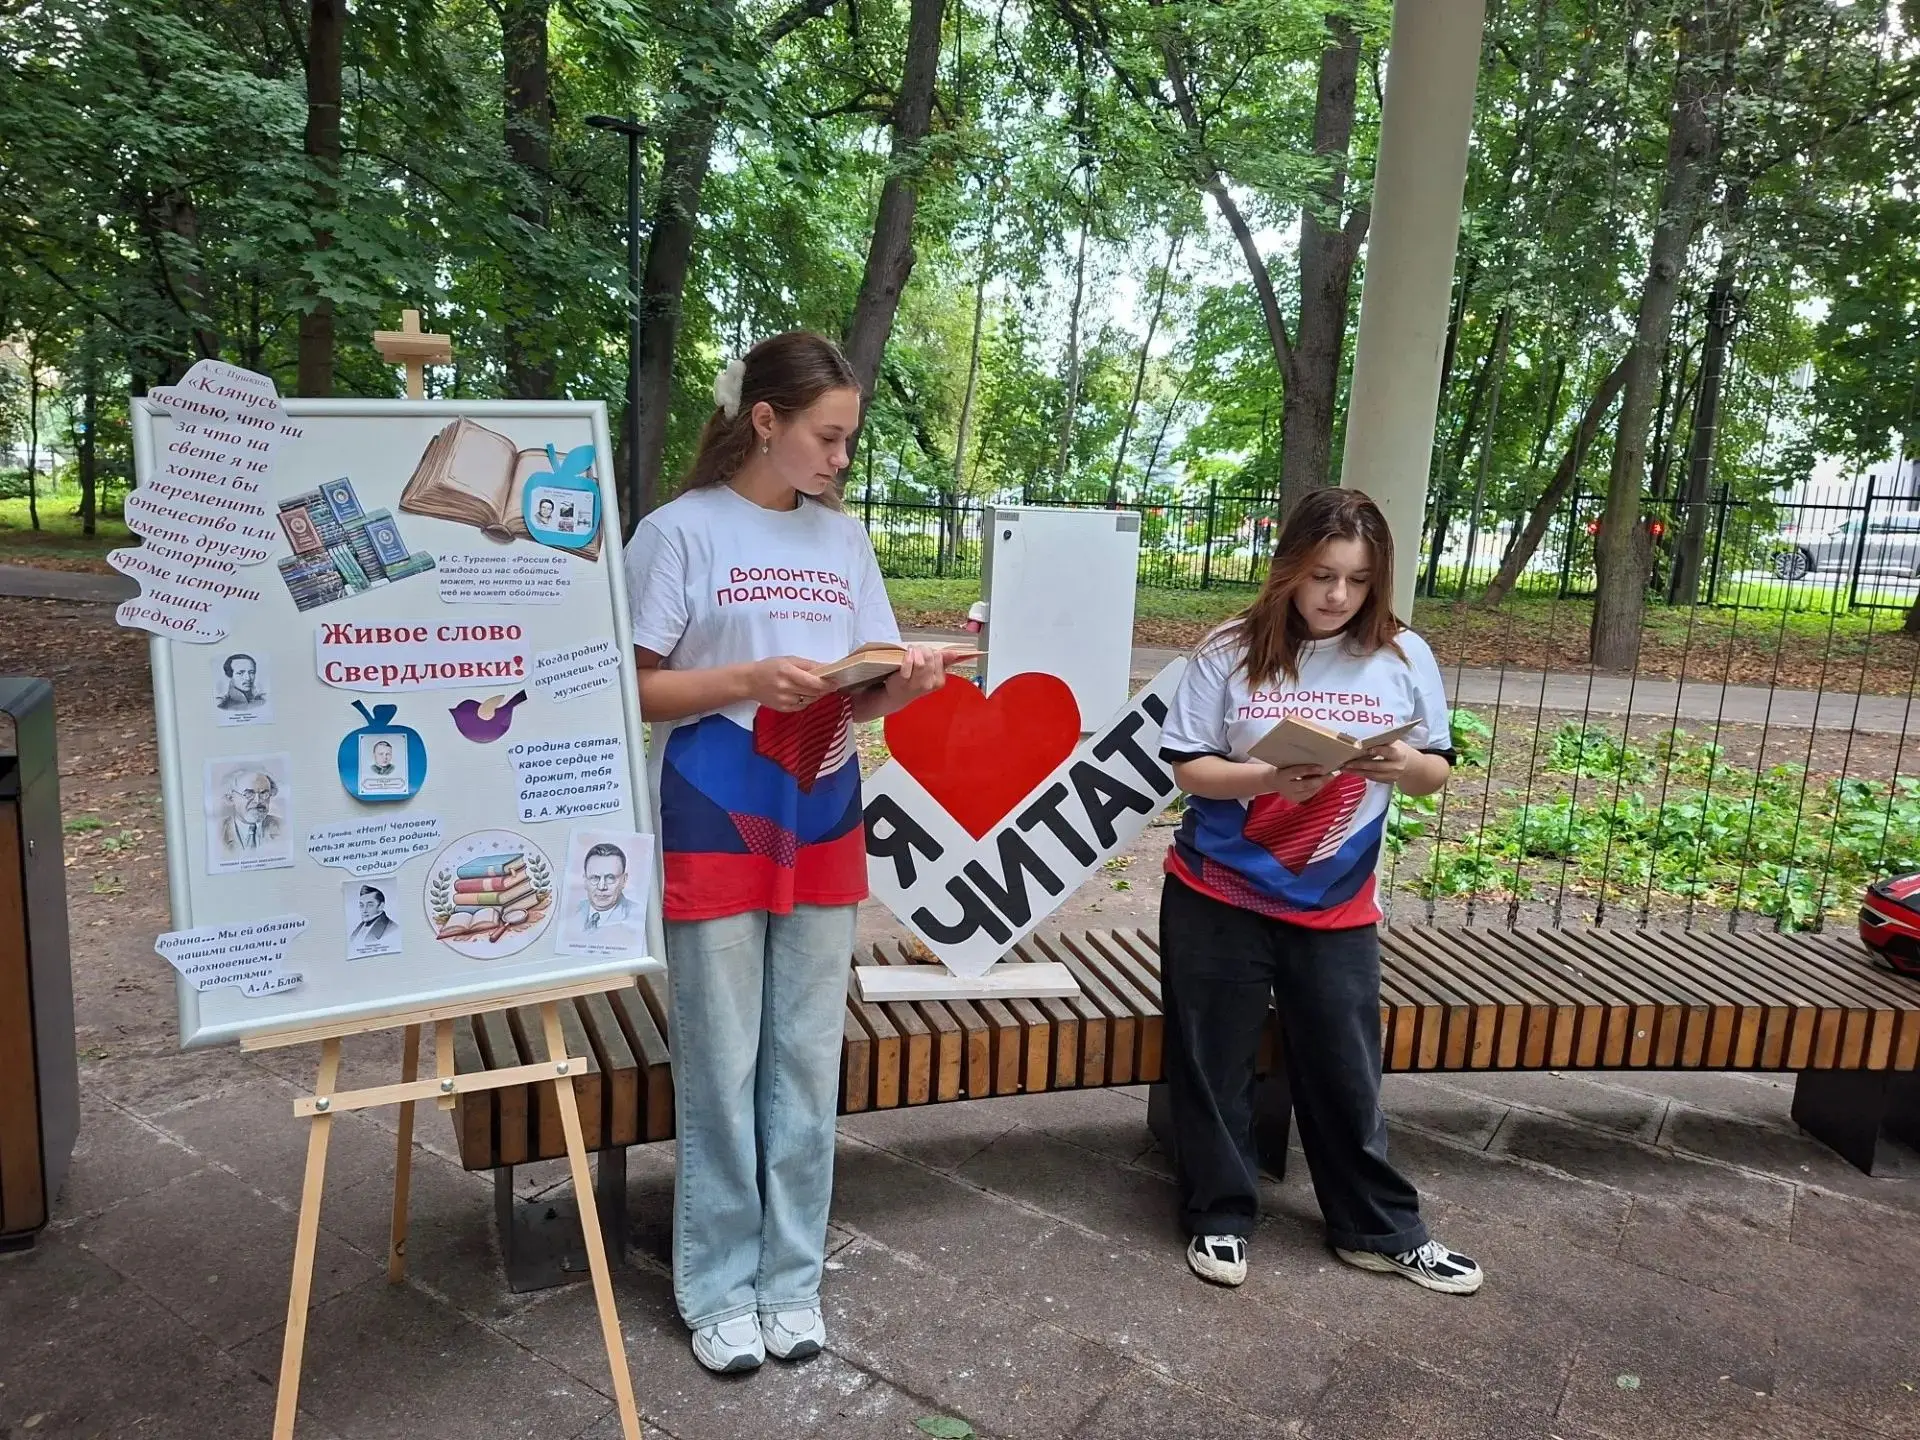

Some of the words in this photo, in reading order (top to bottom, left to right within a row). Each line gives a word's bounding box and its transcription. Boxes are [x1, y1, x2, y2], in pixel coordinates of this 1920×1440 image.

[188, 376, 278, 410] «Клянусь
[151, 389, 230, 422] честью,
[236, 412, 276, 432] что
[280, 424, 304, 440] ни
[176, 420, 196, 434] за
[203, 428, 242, 446] что
[248, 437, 270, 452] на
[169, 440, 225, 463] свете
[230, 456, 242, 468] я
[247, 460, 269, 474] не
[166, 463, 227, 487] хотел
[232, 476, 260, 494] бы
[149, 479, 266, 518] переменить
[129, 496, 236, 532] отечество
[242, 524, 277, 541] или
[128, 516, 190, 545] иметь
[196, 535, 268, 562] другую
[146, 540, 239, 576] историю,
[112, 552, 171, 580] кроме
[176, 573, 262, 601] истории
[513, 567, 559, 575] обойтись
[730, 567, 850, 592] ВОЛОНТЕРЫ
[149, 589, 212, 612] наших
[769, 610, 788, 619] МЫ
[793, 610, 832, 622] РЯДОМ
[321, 622, 429, 645] Живое
[437, 623, 522, 643] слово
[571, 642, 609, 660] родину
[325, 655, 525, 687] Свердловки!
[598, 656, 618, 668] сам
[1252, 690, 1380, 707] ВОЛОНТЕРЫ
[1237, 706, 1394, 727] ПОДМОСКОВЬЯ
[508, 744, 524, 755] «О
[527, 740, 570, 755] родина
[574, 736, 621, 748] святая,
[519, 758, 552, 770] какое
[556, 753, 597, 767] сердце
[601, 752, 614, 761] не
[525, 771, 576, 786] дрожит,
[581, 767, 612, 779] тебя
[520, 781, 619, 801] благословляя?»
[524, 808, 536, 819] В.
[539, 806, 551, 817] А.
[555, 799, 620, 816] Жуковский
[357, 823, 387, 834] «Нет!
[390, 819, 437, 830] Человеку
[309, 843, 345, 853] нельзя
[347, 839, 377, 847] жить
[380, 836, 396, 844] без
[399, 831, 441, 843] родины,
[863, 793, 944, 889] Я
[323, 855, 340, 864] как
[343, 852, 378, 860] нельзя
[381, 848, 410, 856] жить
[413, 843, 429, 851] без
[356, 860, 398, 872] сердца»
[218, 930, 237, 940] Мы
[240, 926, 253, 936] ей
[256, 920, 305, 934] обязаны
[177, 947, 226, 961] нашими
[275, 952, 282, 960] и
[200, 970, 273, 989] радостями»
[248, 984, 260, 993] А.
[263, 981, 275, 990] А.
[278, 974, 303, 987] Блок
